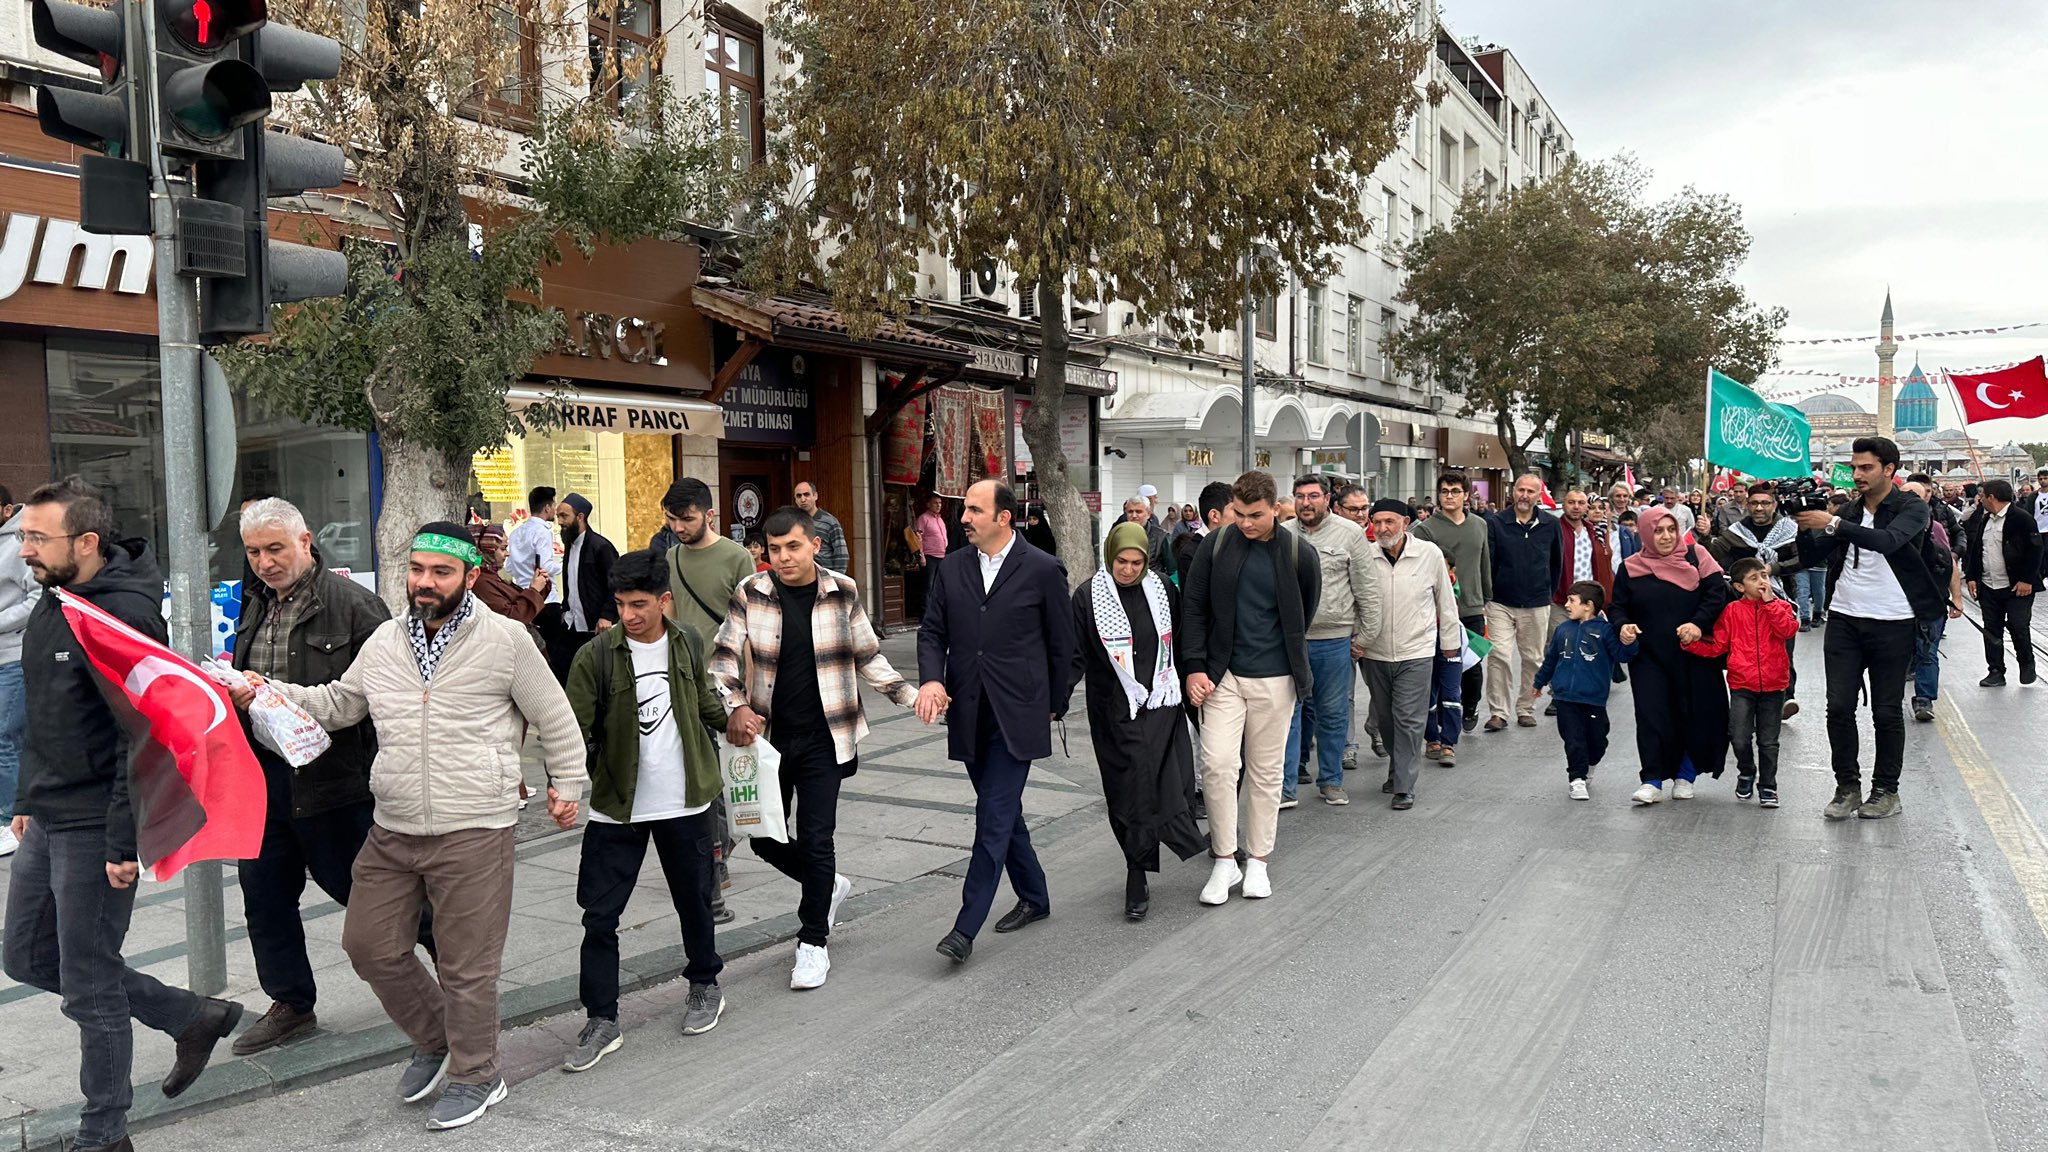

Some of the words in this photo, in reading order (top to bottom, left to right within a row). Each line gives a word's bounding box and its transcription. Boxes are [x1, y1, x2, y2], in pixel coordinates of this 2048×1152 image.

[974, 350, 1017, 372] SELÇUK
[741, 385, 808, 409] MÜDÜRLÜĞÜ
[627, 408, 690, 431] PANCI
[723, 410, 754, 429] ZMET
[757, 409, 793, 430] BİNASI
